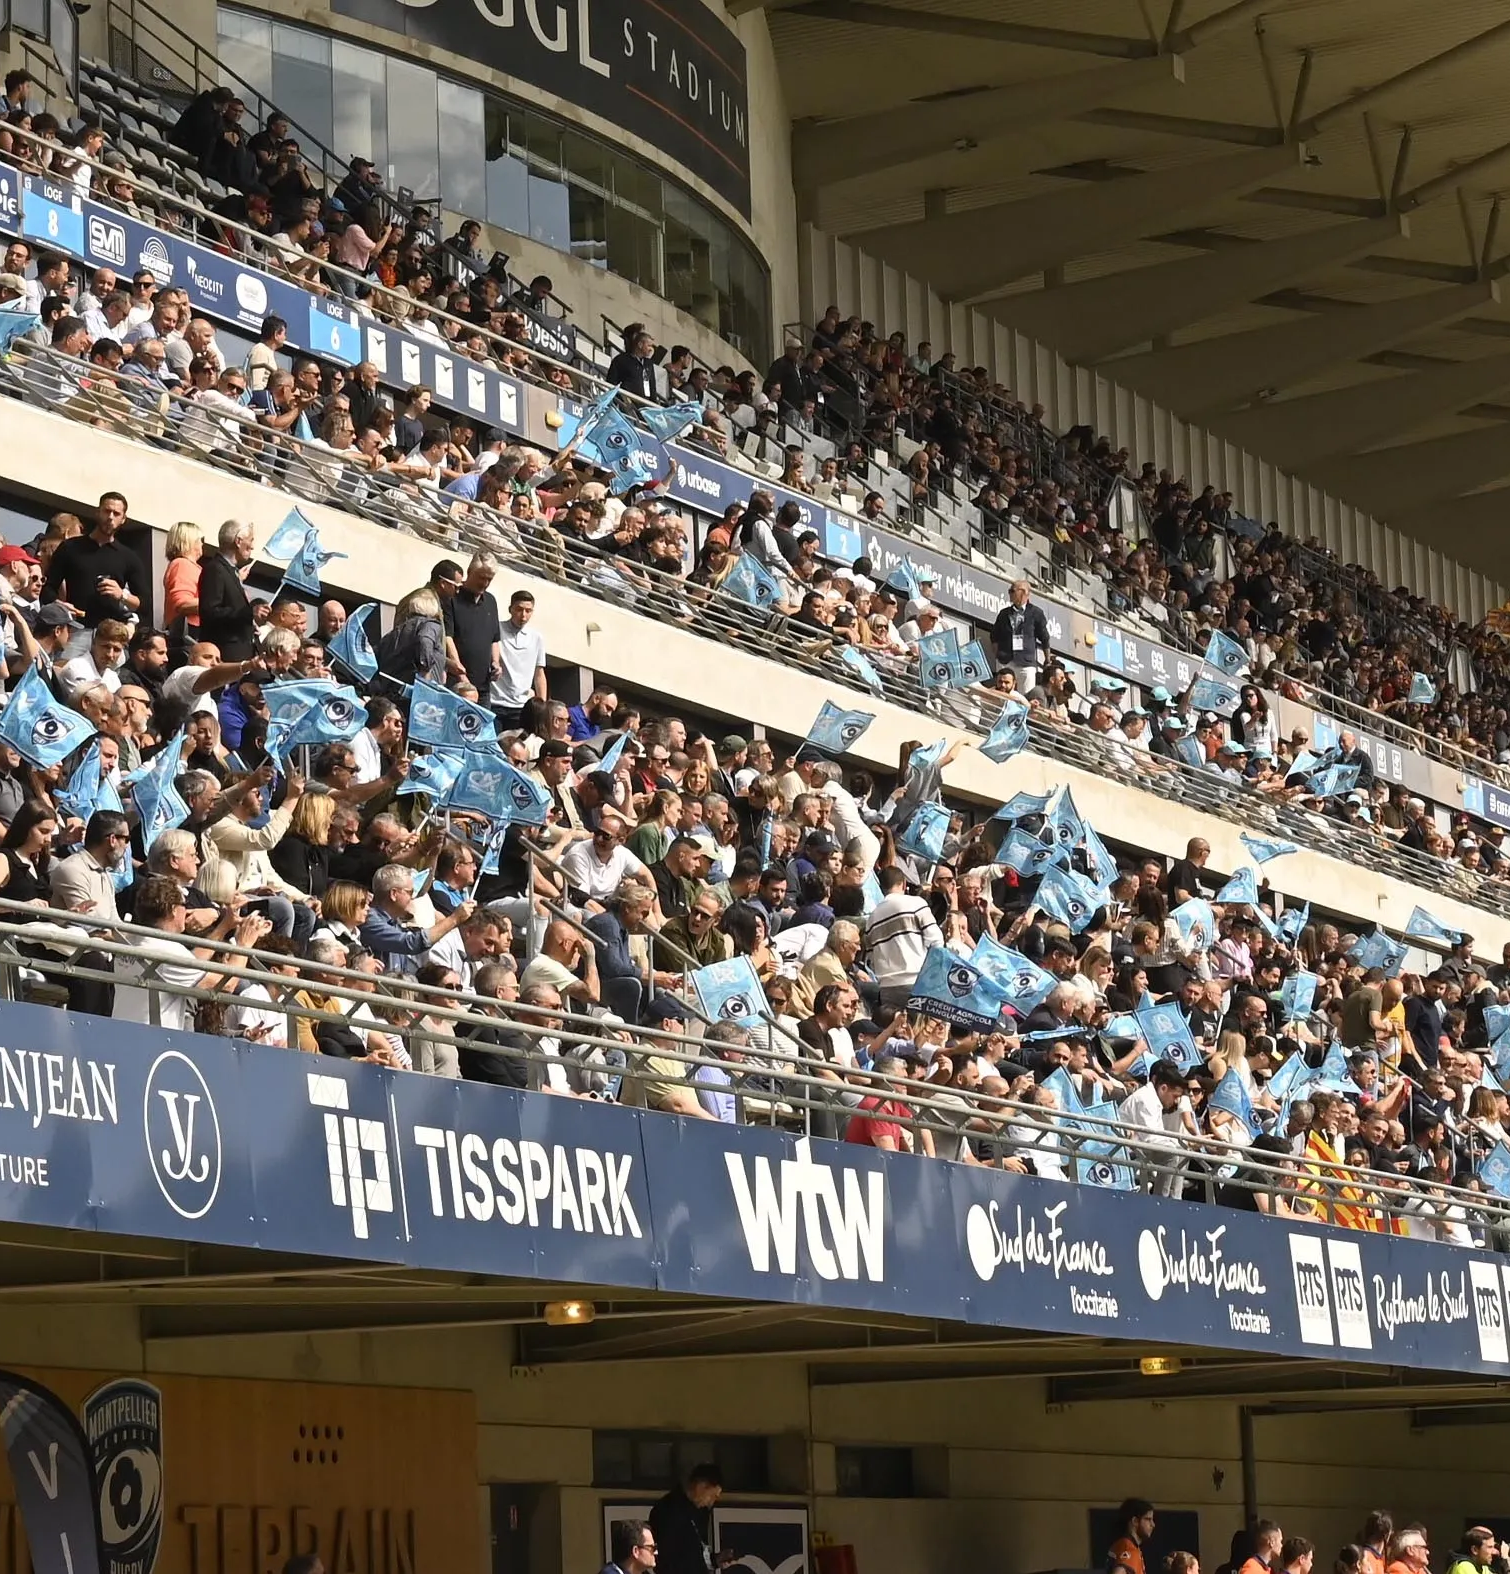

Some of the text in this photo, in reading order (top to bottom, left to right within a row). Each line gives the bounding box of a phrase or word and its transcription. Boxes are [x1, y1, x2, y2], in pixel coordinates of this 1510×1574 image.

[623, 18, 748, 148] STADIUM
[44, 184, 63, 203] LOGE
[48, 209, 58, 237] 8
[194, 274, 224, 296] NEOCITY
[326, 302, 344, 320] LOGE
[330, 329, 340, 350] 6
[687, 470, 721, 498] urbaser
[925, 1005, 974, 1028] LANGUEDOC
[413, 1125, 643, 1240] TISSPARK
[989, 1200, 1115, 1280] Sud de France
[1156, 1224, 1268, 1299] Sud de France
[1296, 1261, 1325, 1308] RTS
[1334, 1267, 1363, 1312] RTS
[1372, 1270, 1469, 1341] Rythme le Sud
[1475, 1286, 1501, 1328] RTS
[88, 1393, 158, 1443] MONTPELLIER
